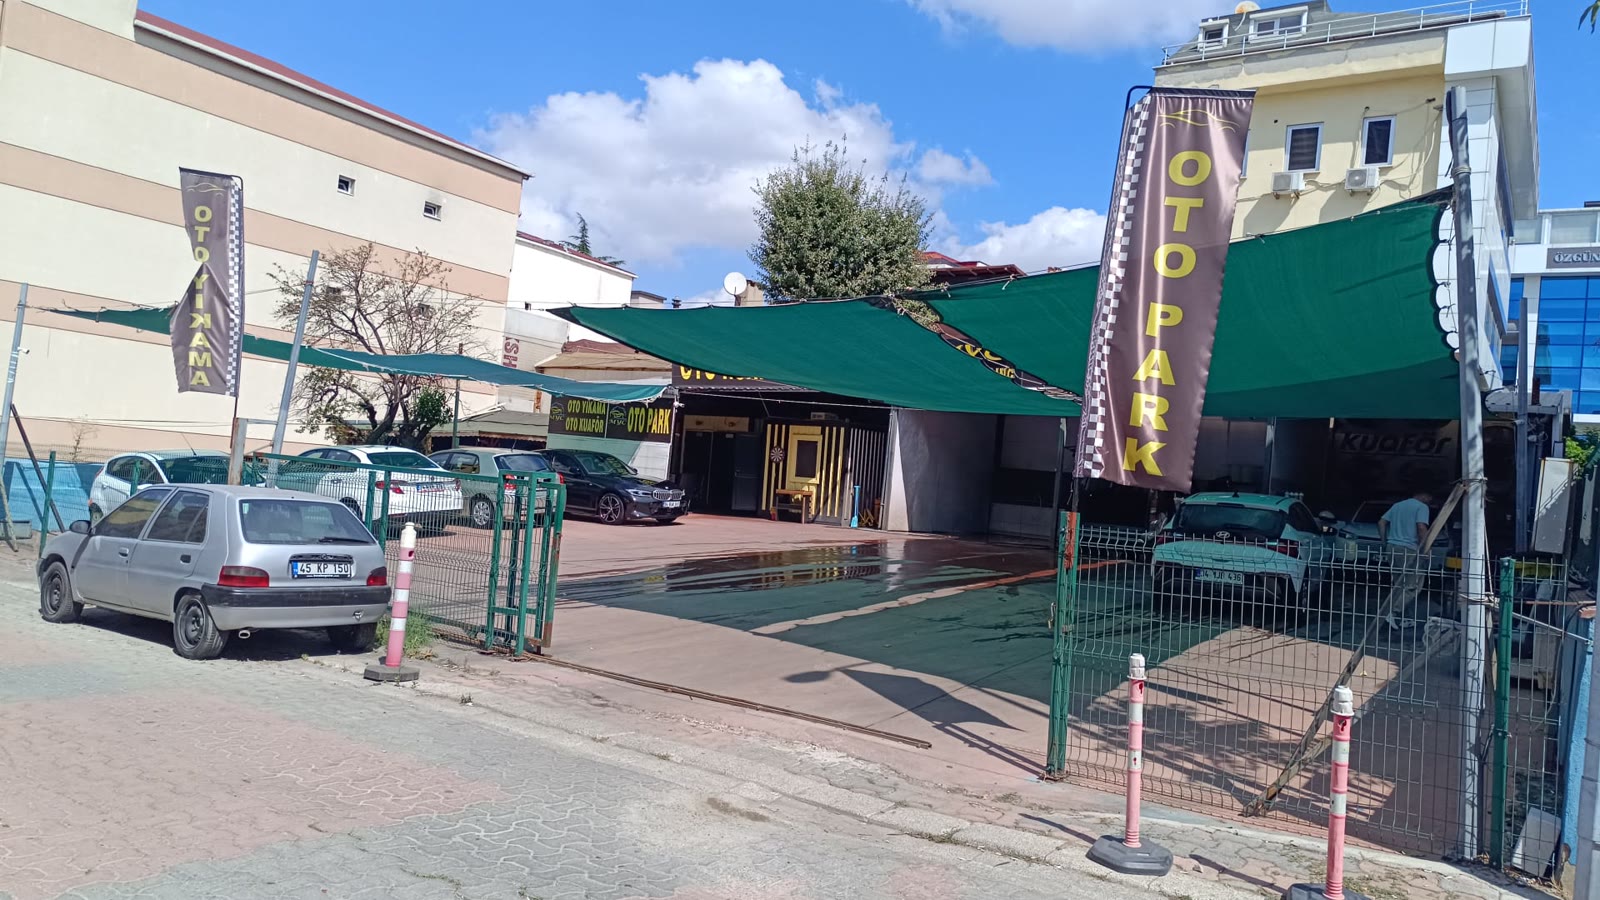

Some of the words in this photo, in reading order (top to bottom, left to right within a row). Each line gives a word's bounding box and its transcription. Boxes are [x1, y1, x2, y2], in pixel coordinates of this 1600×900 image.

[1153, 150, 1212, 279] OTO
[1122, 302, 1184, 477] PARK
[567, 399, 580, 414] OTO
[565, 416, 577, 431] OTO
[627, 407, 646, 433] OTO
[646, 407, 671, 434] PARK
[300, 563, 312, 573] 45
[317, 563, 329, 573] KP
[334, 563, 349, 573] 150
